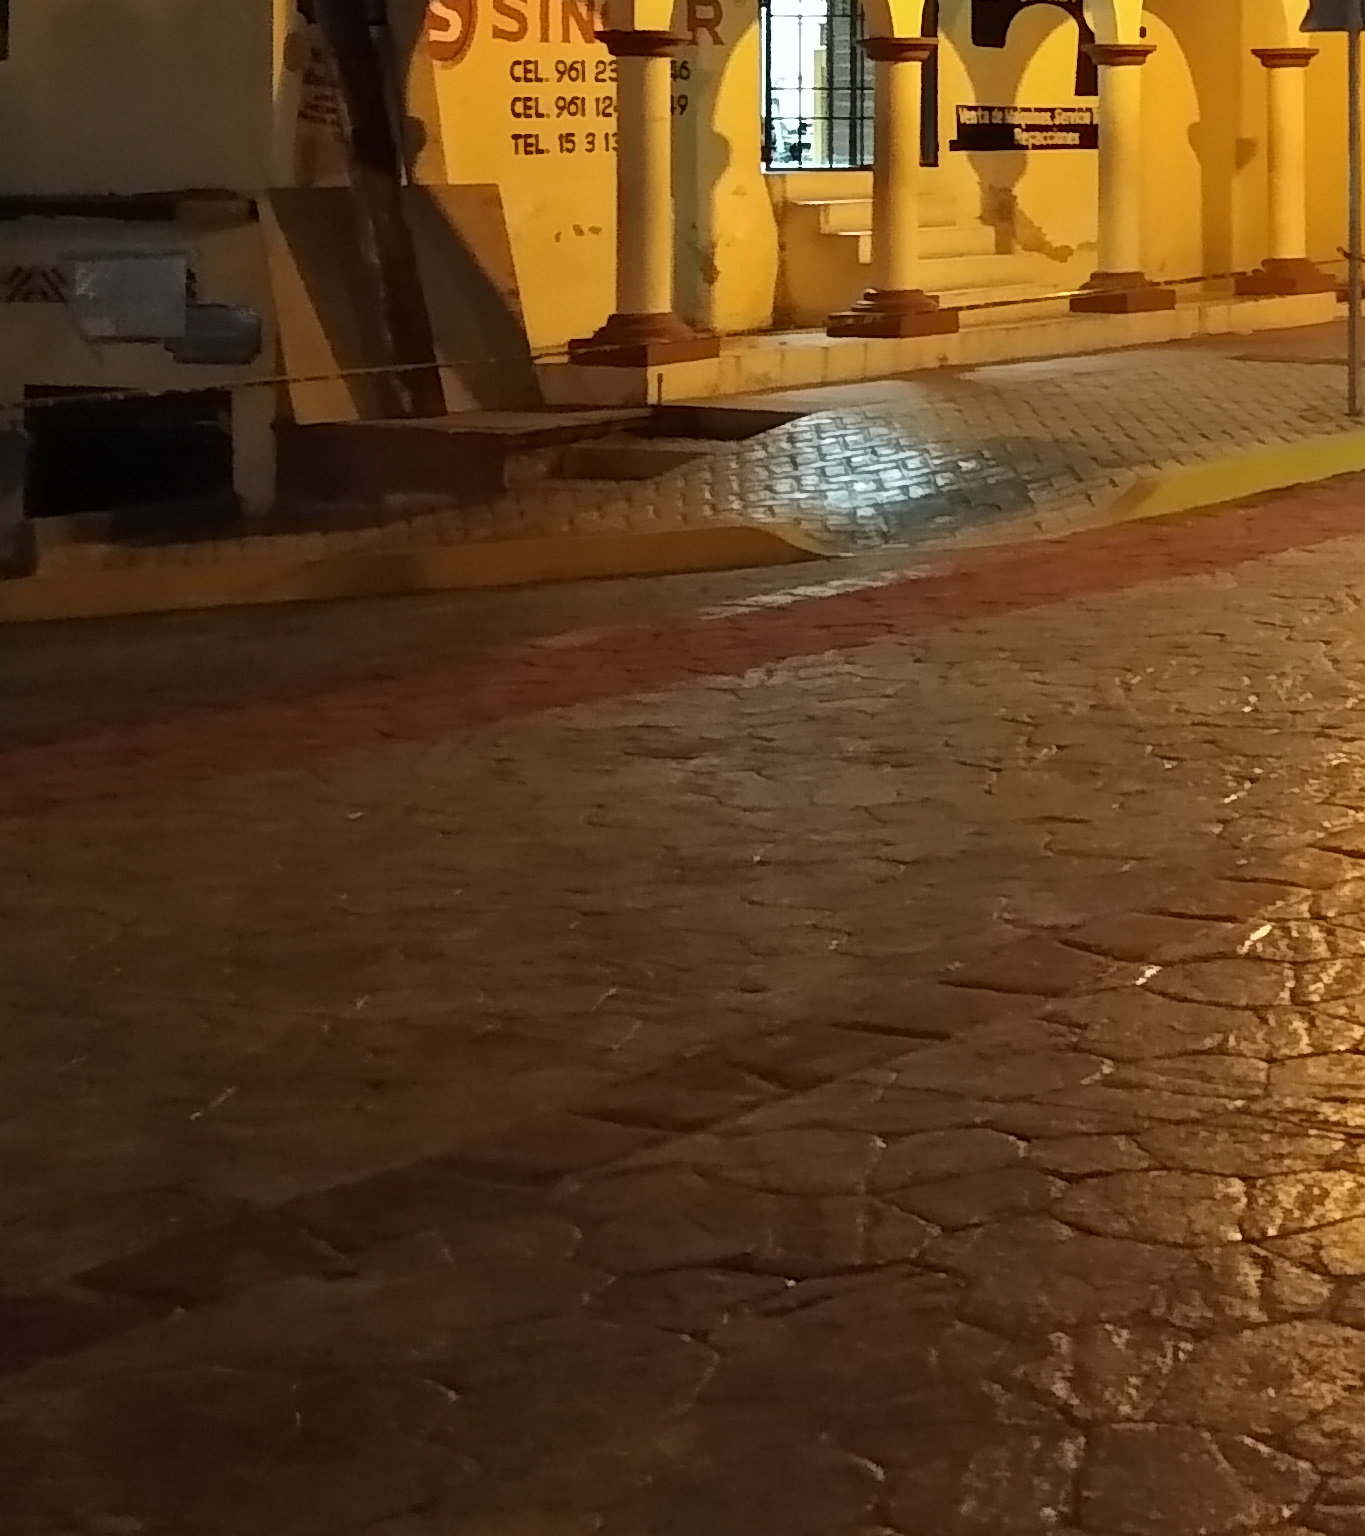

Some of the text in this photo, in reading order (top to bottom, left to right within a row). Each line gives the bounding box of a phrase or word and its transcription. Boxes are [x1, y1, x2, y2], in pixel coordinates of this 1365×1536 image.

[509, 58, 550, 84] CEL.
[554, 58, 587, 84] 961
[510, 95, 551, 119] CEL.
[554, 94, 587, 120] 961
[510, 133, 552, 156] TEL.
[558, 132, 577, 154] 15
[584, 131, 597, 154] 3
